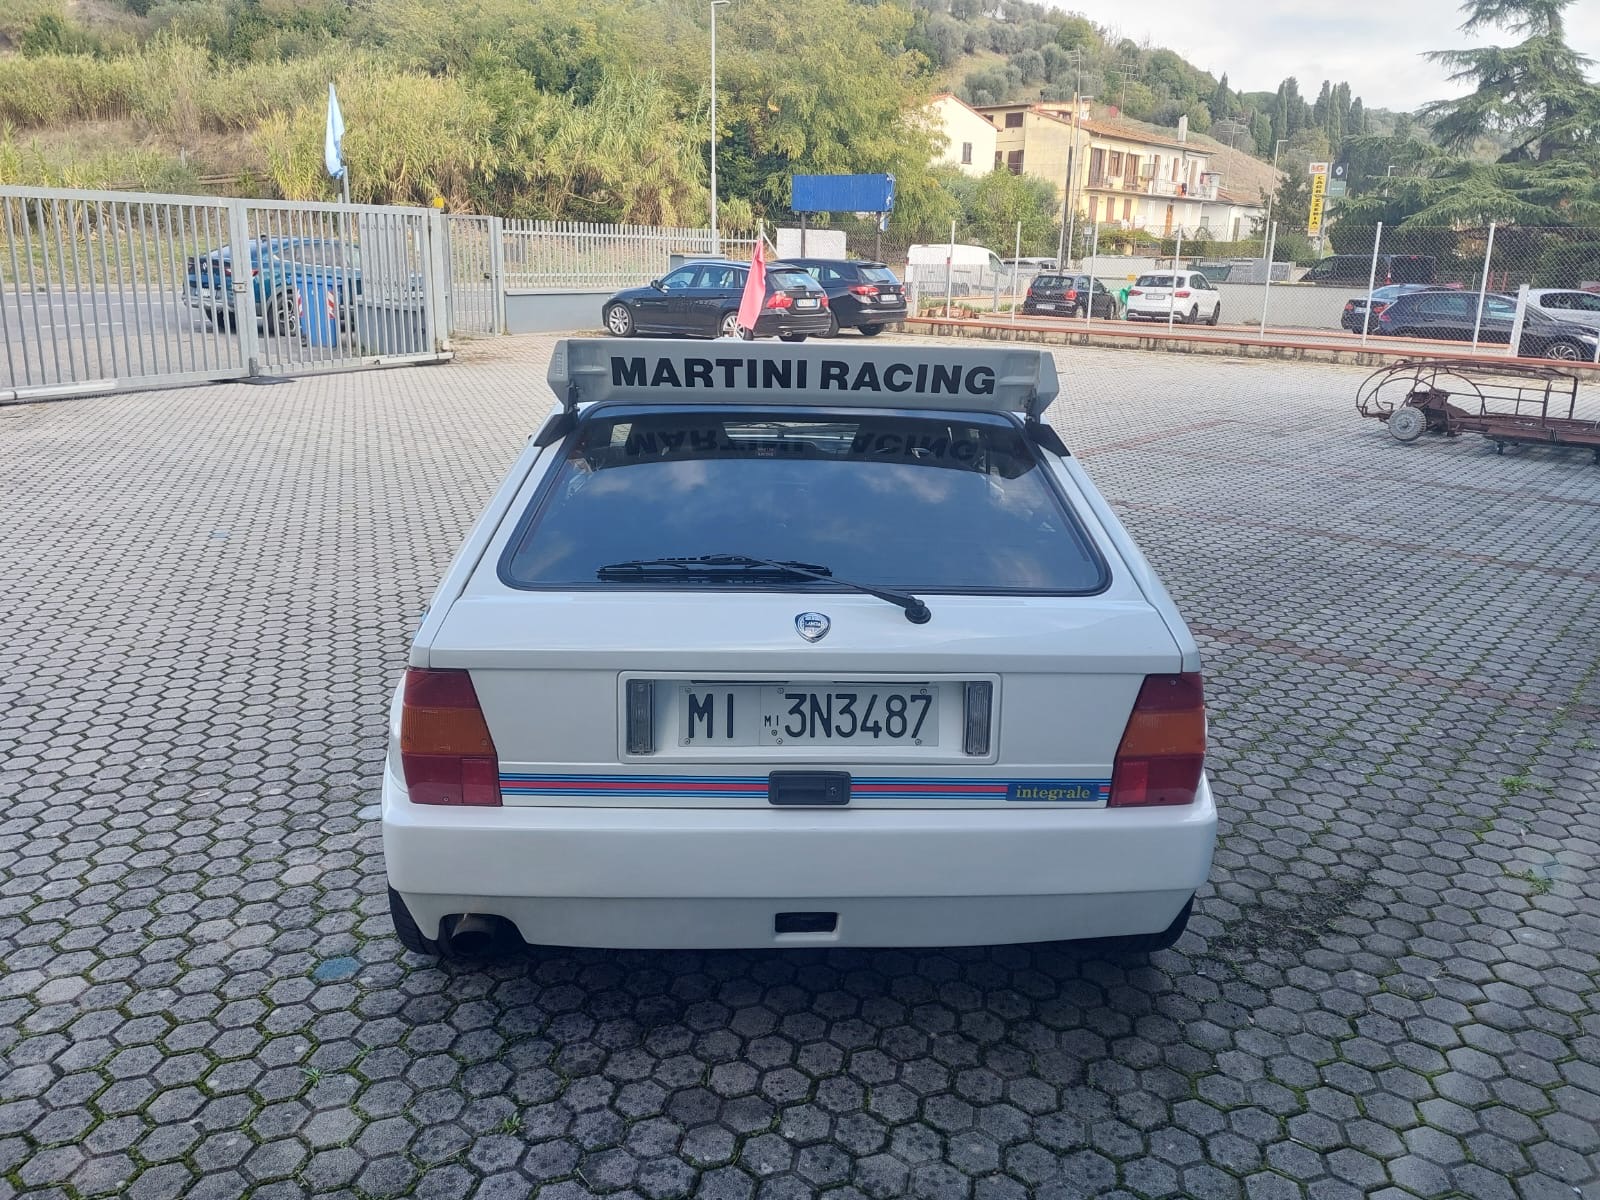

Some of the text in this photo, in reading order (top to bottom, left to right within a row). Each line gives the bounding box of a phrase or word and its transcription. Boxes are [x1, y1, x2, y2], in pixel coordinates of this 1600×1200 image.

[610, 356, 996, 395] MARTINI RACING
[688, 693, 932, 739] MI MI 3N3487
[1016, 785, 1090, 801] integrale
